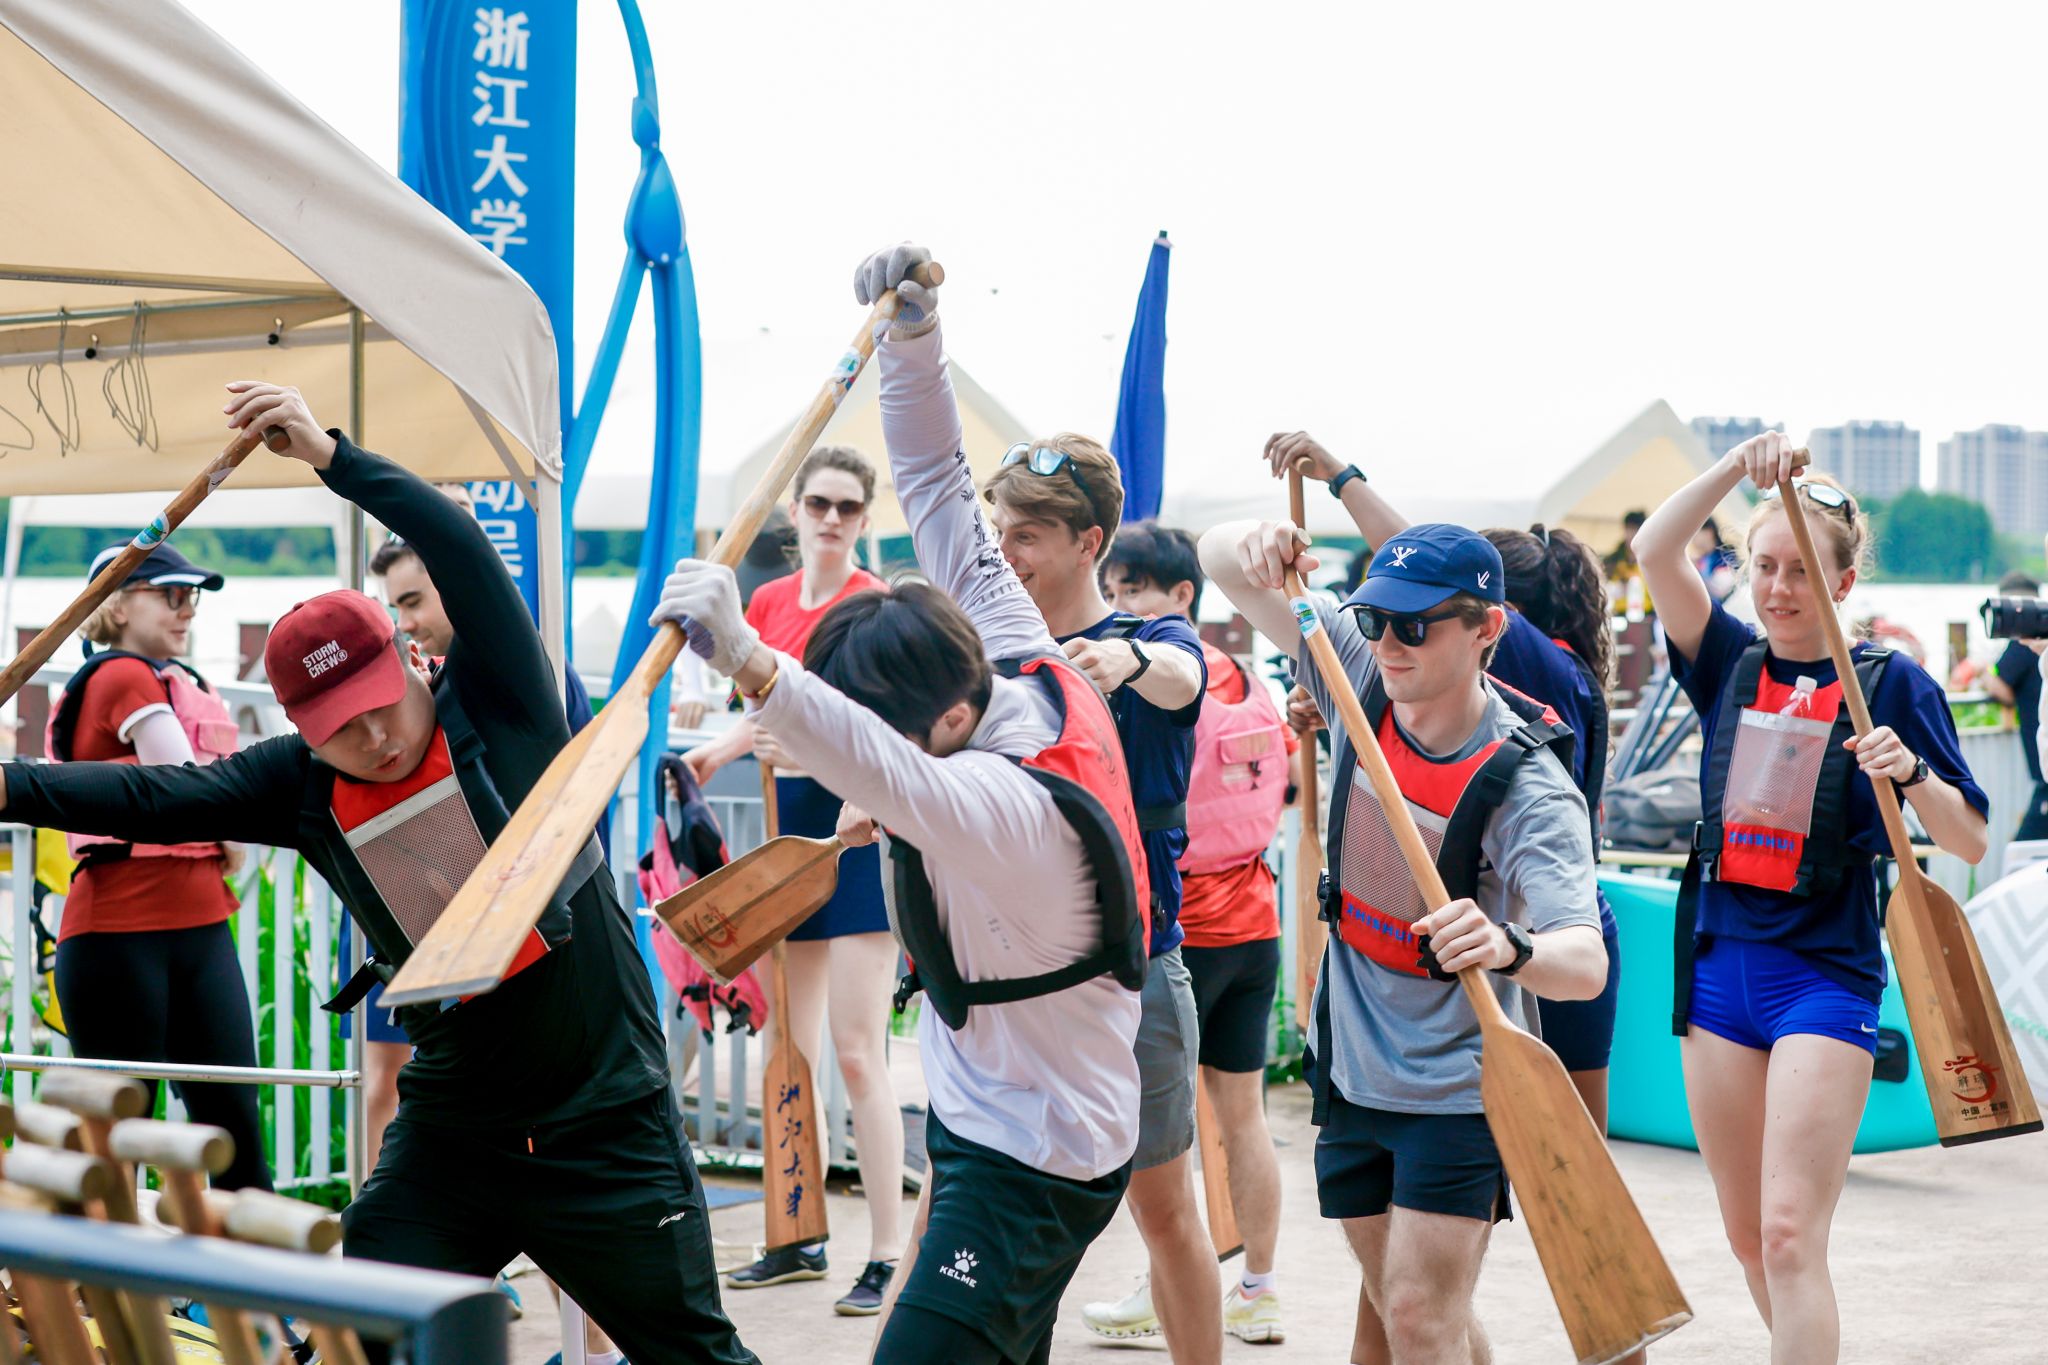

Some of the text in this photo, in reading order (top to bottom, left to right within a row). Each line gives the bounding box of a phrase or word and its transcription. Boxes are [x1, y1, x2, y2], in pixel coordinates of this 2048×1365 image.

[472, 8, 530, 258] 浙江大学
[302, 639, 341, 669] STORM
[939, 1265, 978, 1288] KELME
